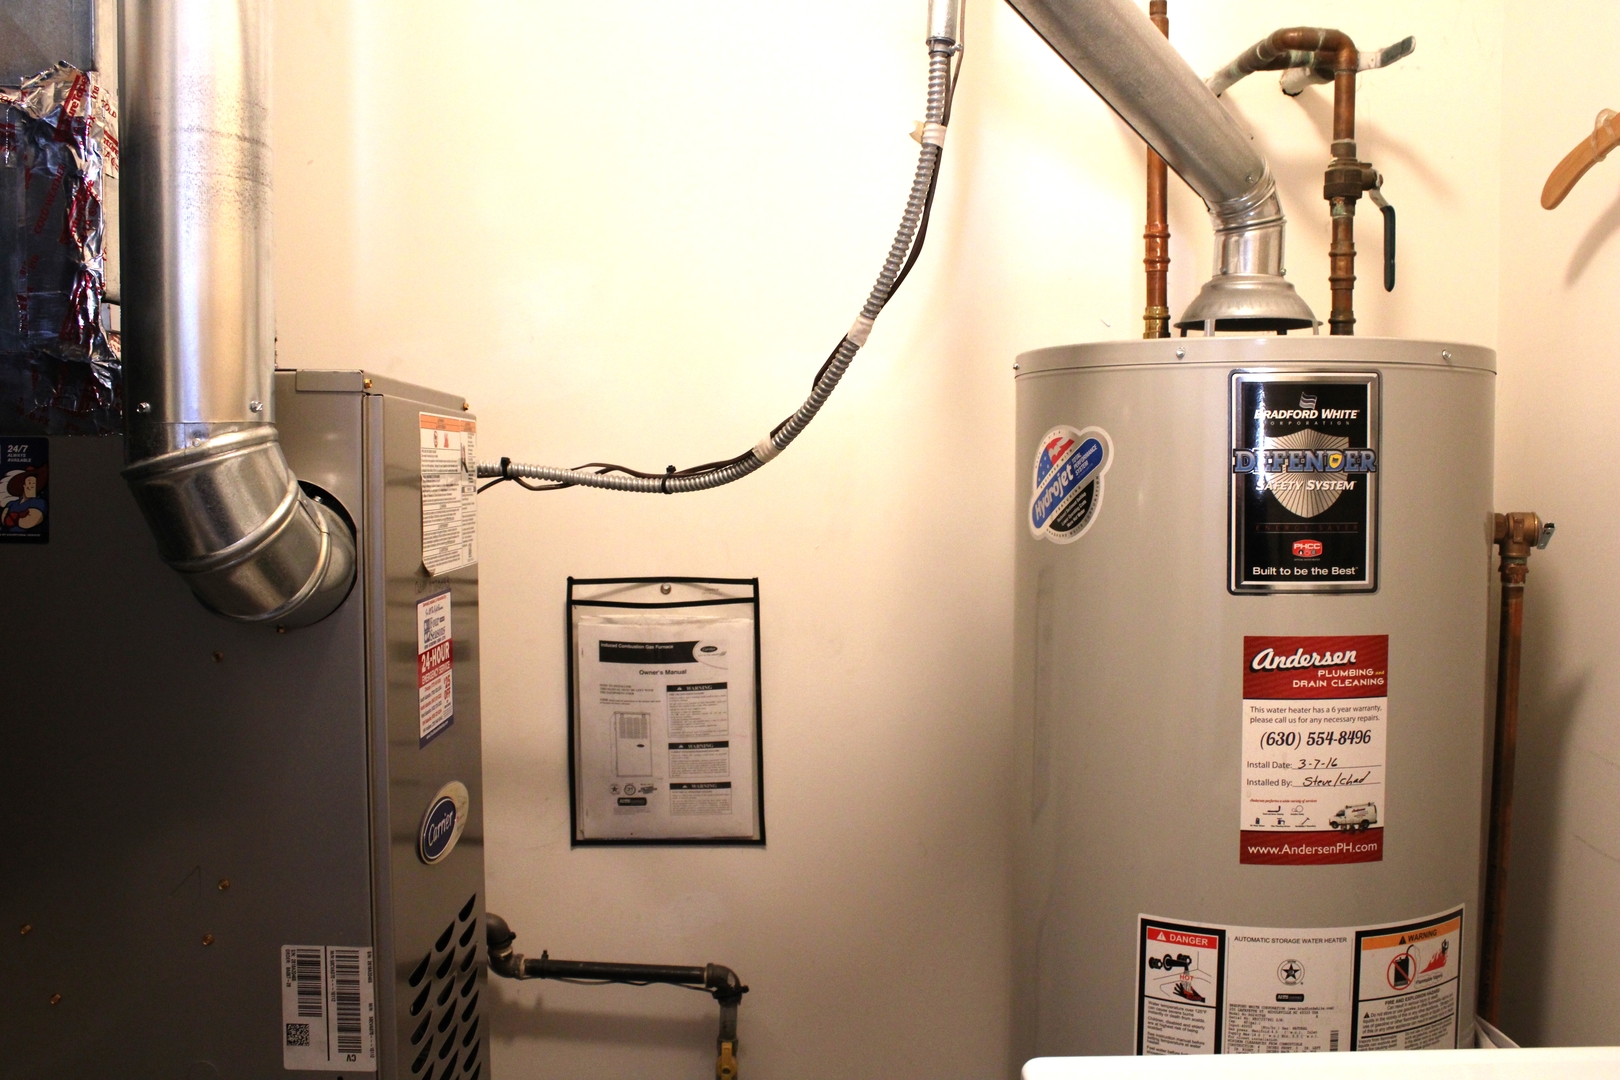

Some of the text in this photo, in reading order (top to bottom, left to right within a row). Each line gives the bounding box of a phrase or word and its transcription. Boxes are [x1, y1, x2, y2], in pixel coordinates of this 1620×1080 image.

[34, 164, 66, 234] COLD WEATHER
[1254, 409, 1358, 419] BRADFORD WHITE
[7, 445, 28, 453] 24/7
[1071, 452, 1082, 464] TOTAL
[1073, 444, 1098, 470] PERFORMANCE
[1233, 448, 1377, 473] DEFENDER
[1075, 460, 1089, 476] SYSTEM
[1034, 463, 1074, 520] Hydrojet
[1256, 480, 1355, 491] SAFETY SYSTEM
[1055, 485, 1081, 513] FEATURING
[1252, 566, 1356, 576] Built to be the Best
[421, 642, 450, 673] 24-HOUR
[1251, 648, 1357, 671] Andersen
[422, 660, 451, 685] EMERGENCY SERVICE
[1317, 668, 1374, 677] PLUMBING
[1292, 678, 1385, 688] DRAIN CLEANING
[1357, 715, 1380, 723] repairs.
[1260, 729, 1371, 750] (630) 554-8496
[1298, 757, 1338, 769] 3-7-16
[1246, 778, 1293, 788] Installed By:
[428, 811, 453, 846] Carrier
[1248, 843, 1378, 855] www.AndersenPH.com
[1169, 934, 1208, 946] DANGER
[1234, 936, 1270, 944] AUTOMATIC
[1408, 929, 1437, 942] WARNING
[1405, 993, 1426, 1002] EXPLOSION
[346, 1054, 356, 1062] CV
